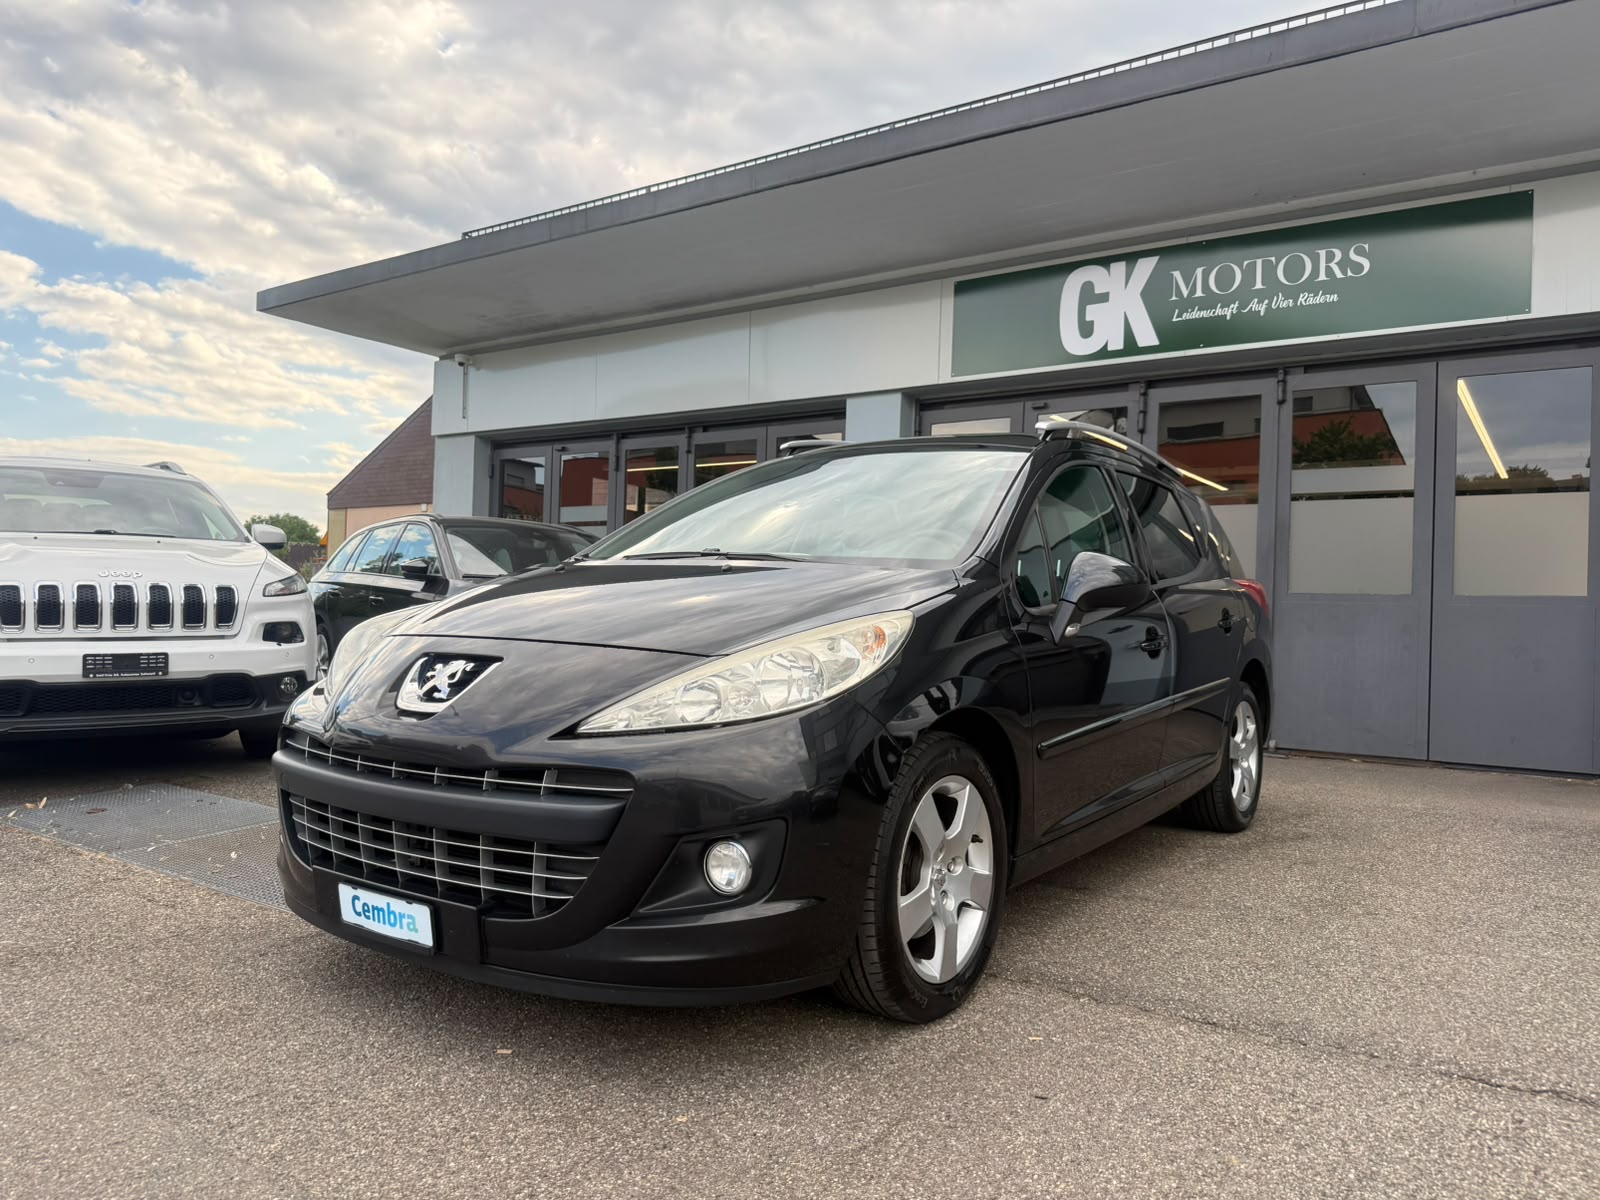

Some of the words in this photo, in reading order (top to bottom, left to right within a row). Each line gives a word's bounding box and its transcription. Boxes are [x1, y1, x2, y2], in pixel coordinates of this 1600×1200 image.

[1059, 255, 1160, 356] GK
[1169, 243, 1371, 301] MOTORS
[1172, 300, 1239, 322] Leidenschaft
[1241, 298, 1269, 316] Auf
[1272, 292, 1295, 310] Vier
[1297, 290, 1339, 306] Rädern
[98, 569, 143, 579] Jeep
[351, 894, 419, 934] Cembra
